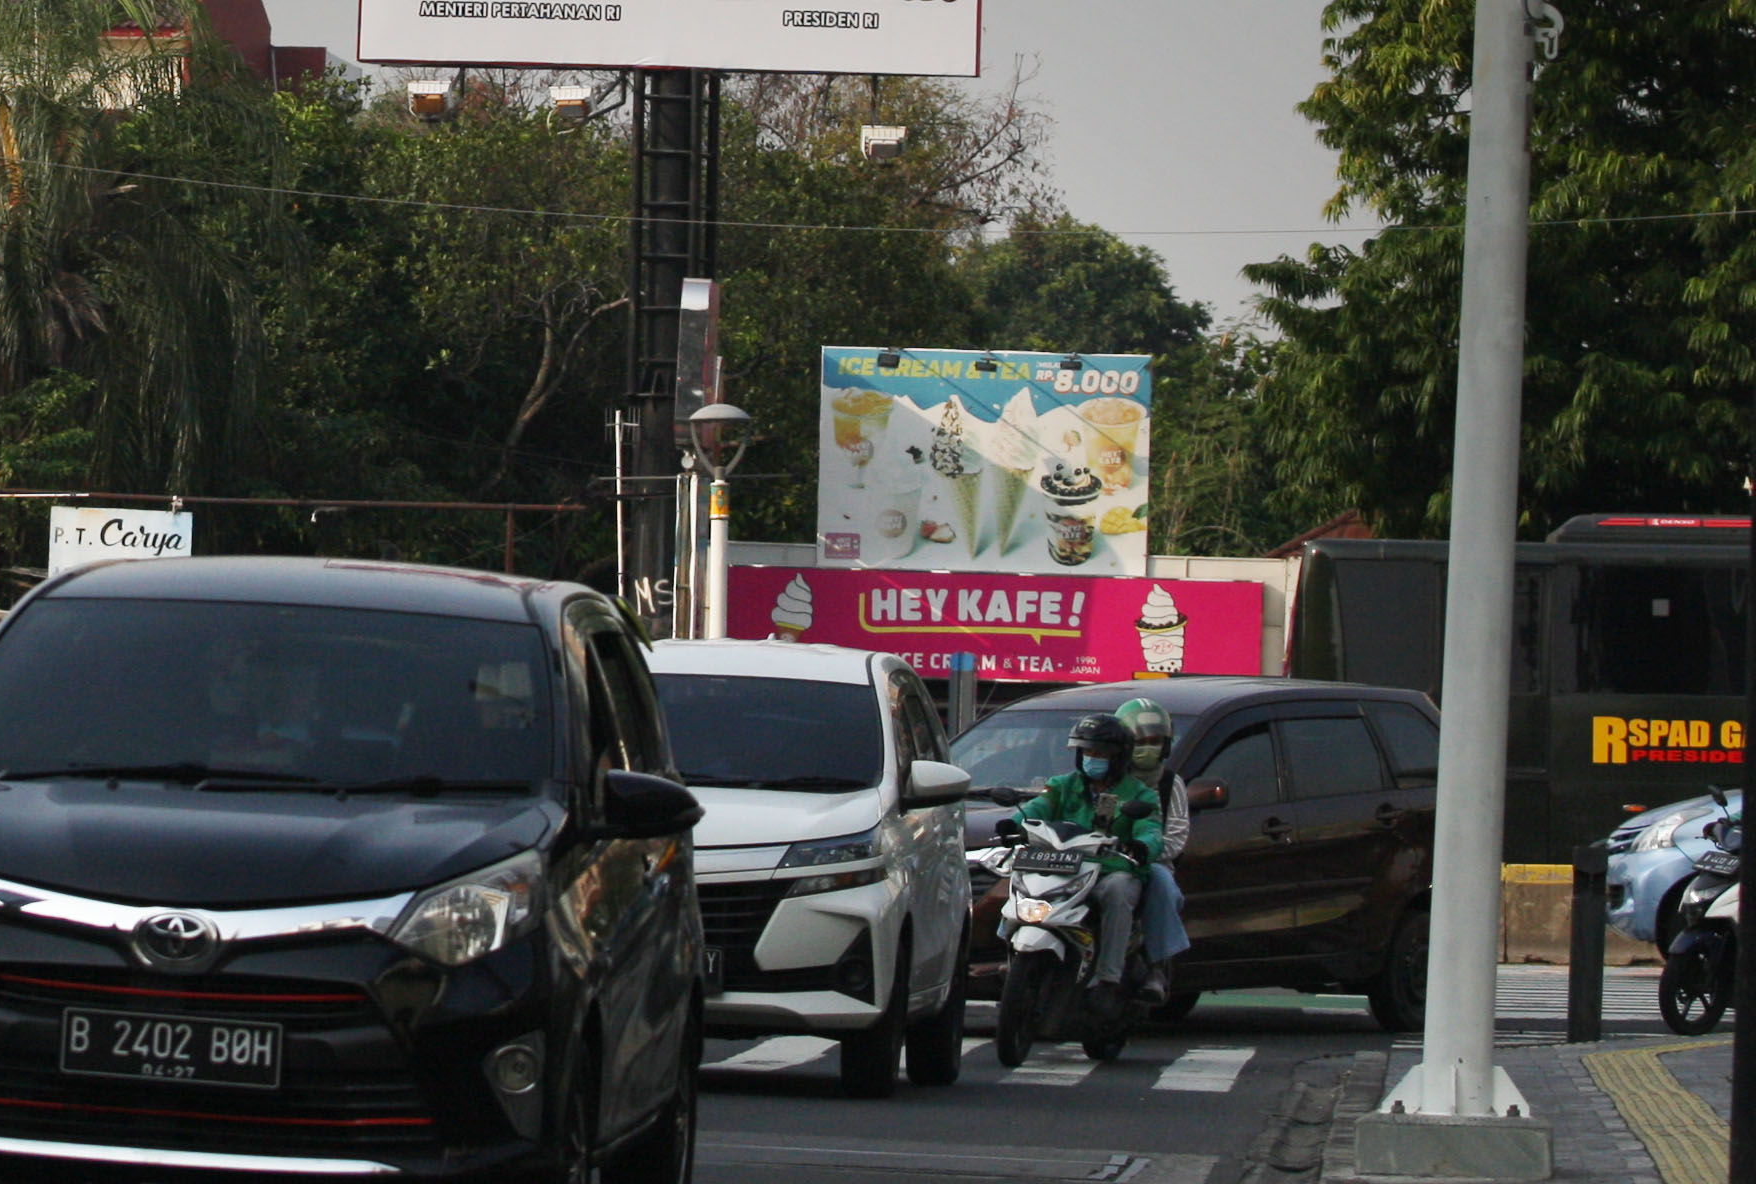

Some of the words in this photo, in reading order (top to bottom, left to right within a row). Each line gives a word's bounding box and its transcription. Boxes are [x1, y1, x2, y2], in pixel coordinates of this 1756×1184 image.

[419, 0, 488, 18] MENTERI
[491, 2, 602, 21] PERTAHANAN
[605, 4, 622, 21] RI
[782, 10, 860, 29] PRESIDEN
[863, 12, 880, 29] RI
[837, 357, 876, 376] ICE
[1054, 369, 1140, 395] 8.000
[100, 518, 186, 557] Carya
[871, 587, 949, 622] HEY
[957, 588, 1086, 627] KAFE!
[930, 653, 996, 671] CRM
[1018, 656, 1054, 673] TEA
[1069, 665, 1101, 675] JAPAN
[70, 1016, 90, 1053] B
[112, 1019, 193, 1060] 2402
